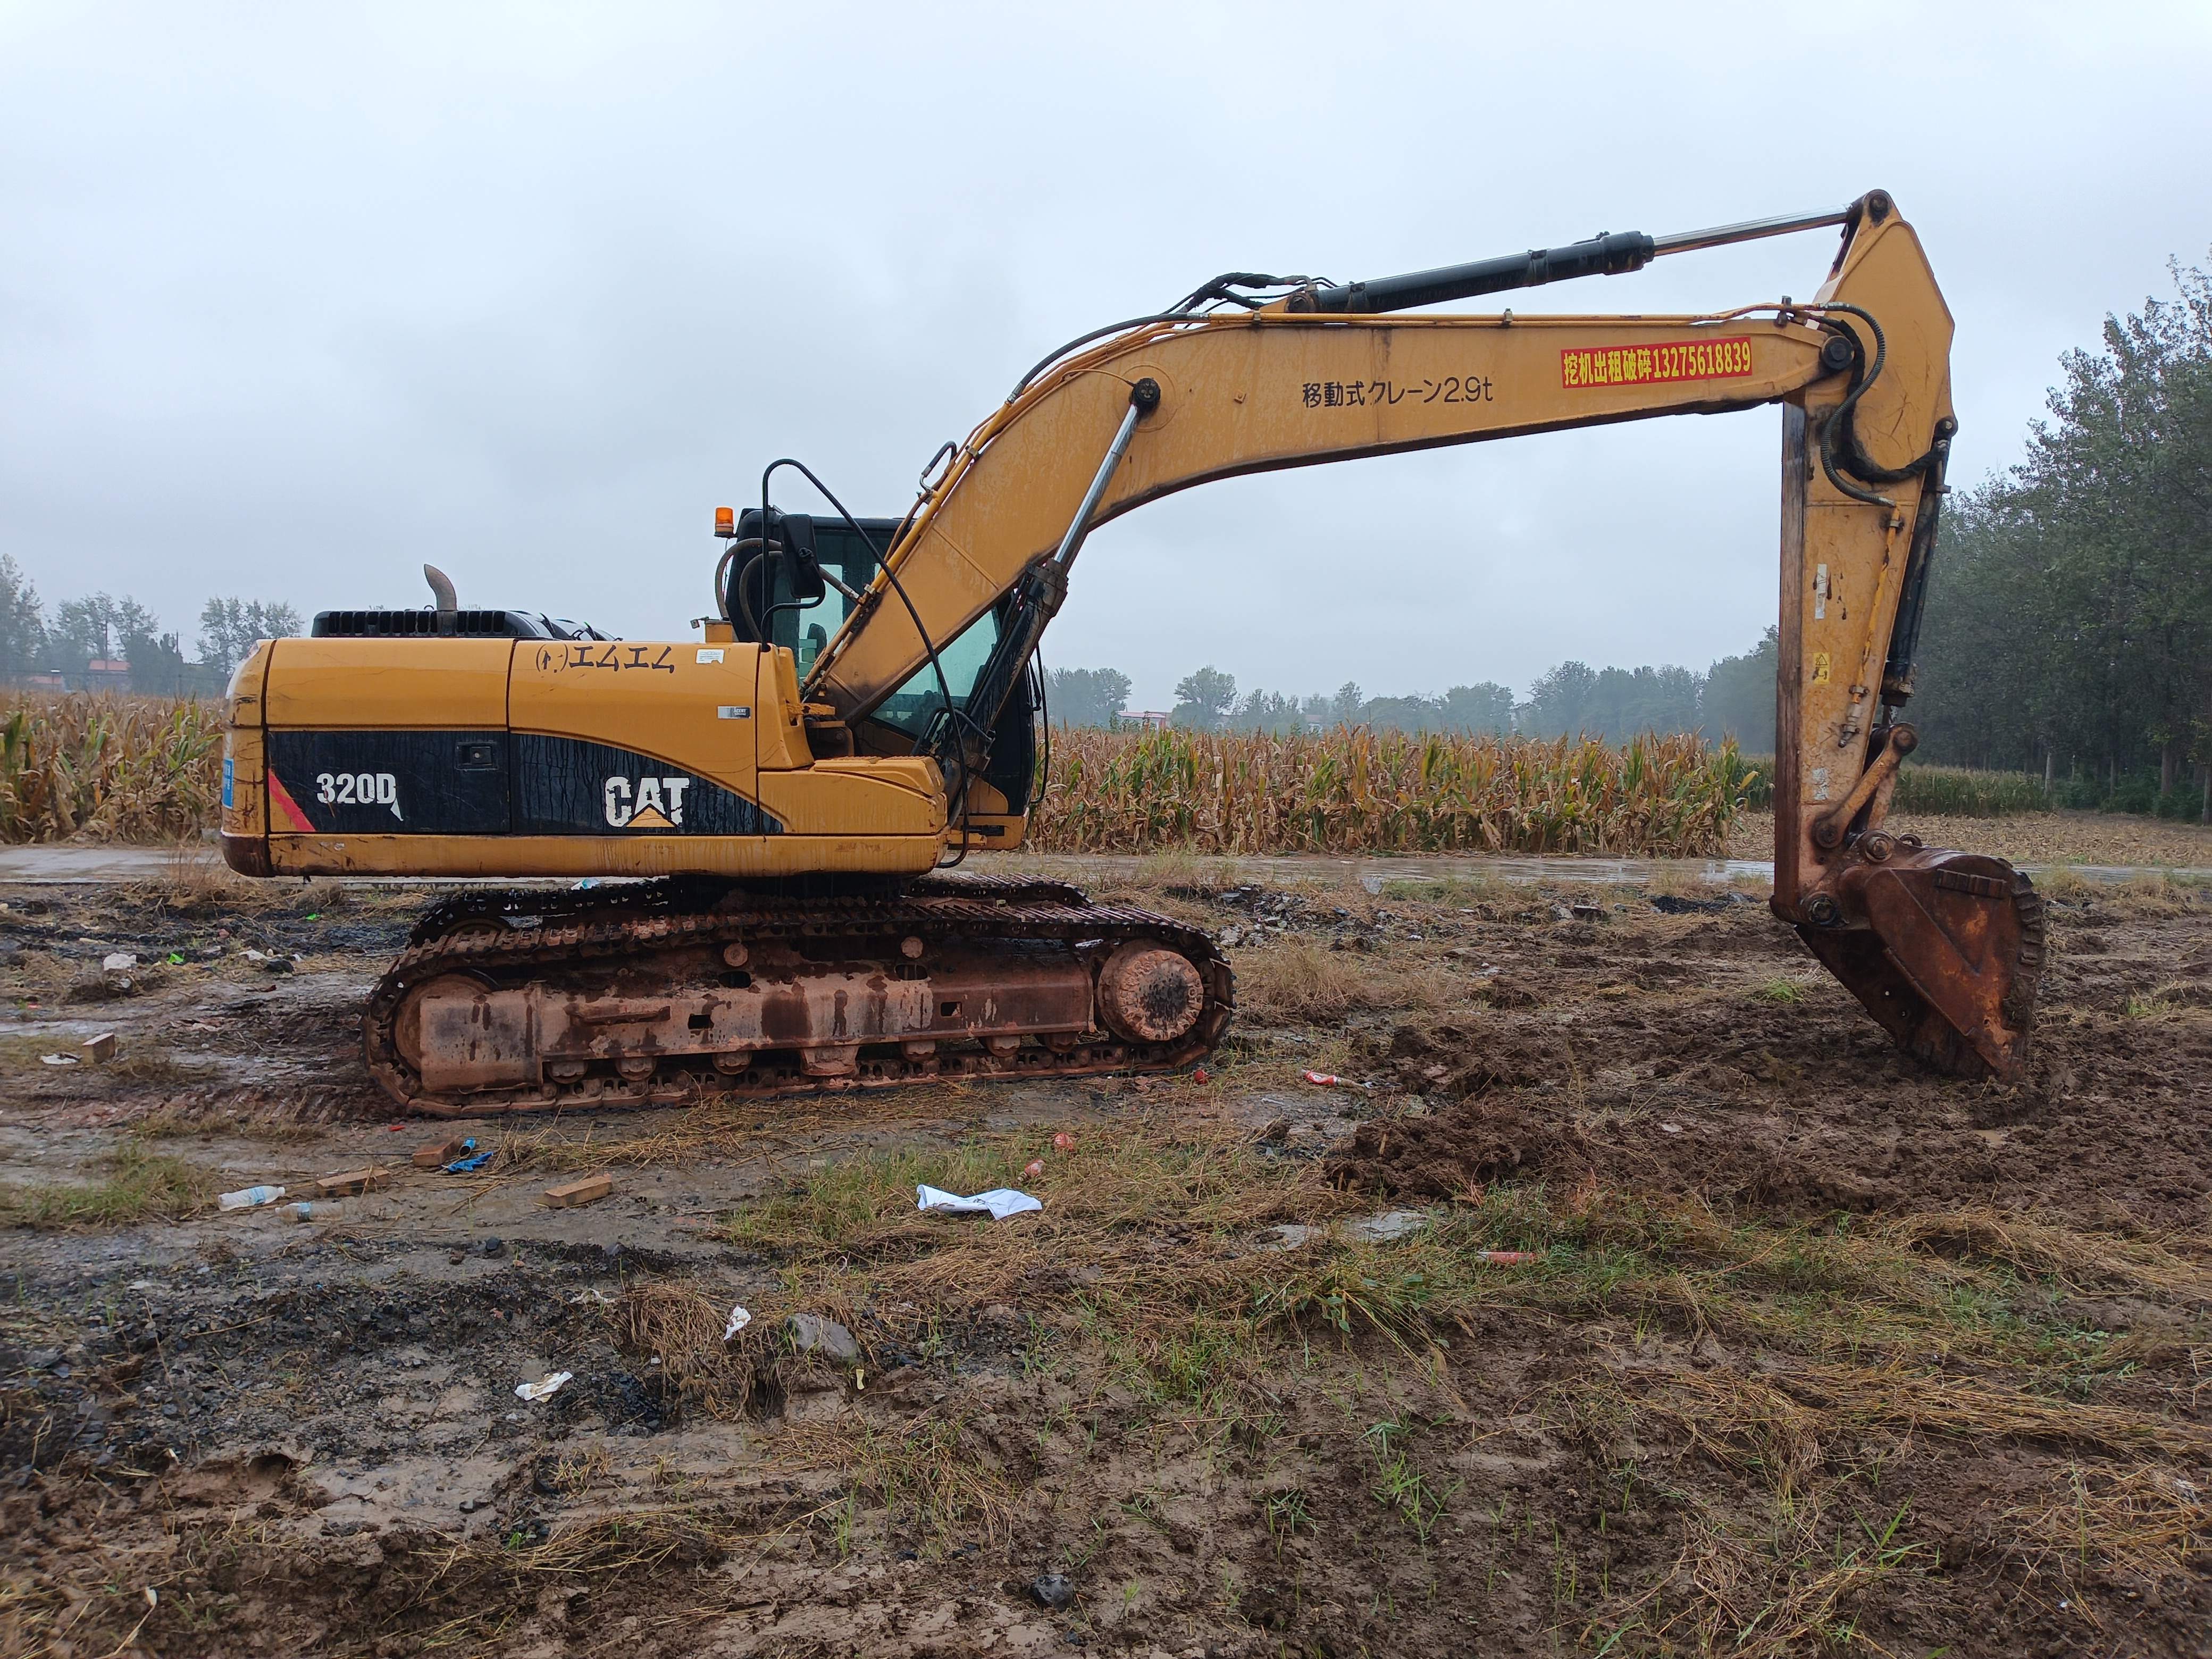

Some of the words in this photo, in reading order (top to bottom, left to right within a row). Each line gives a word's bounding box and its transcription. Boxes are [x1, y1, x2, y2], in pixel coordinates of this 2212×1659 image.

[1564, 341, 1751, 386] 挖机出租破碎13275618839
[1302, 376, 1494, 408] 移動式クレーン2.9t
[316, 773, 396, 804] 320D
[605, 776, 690, 827] CAT
